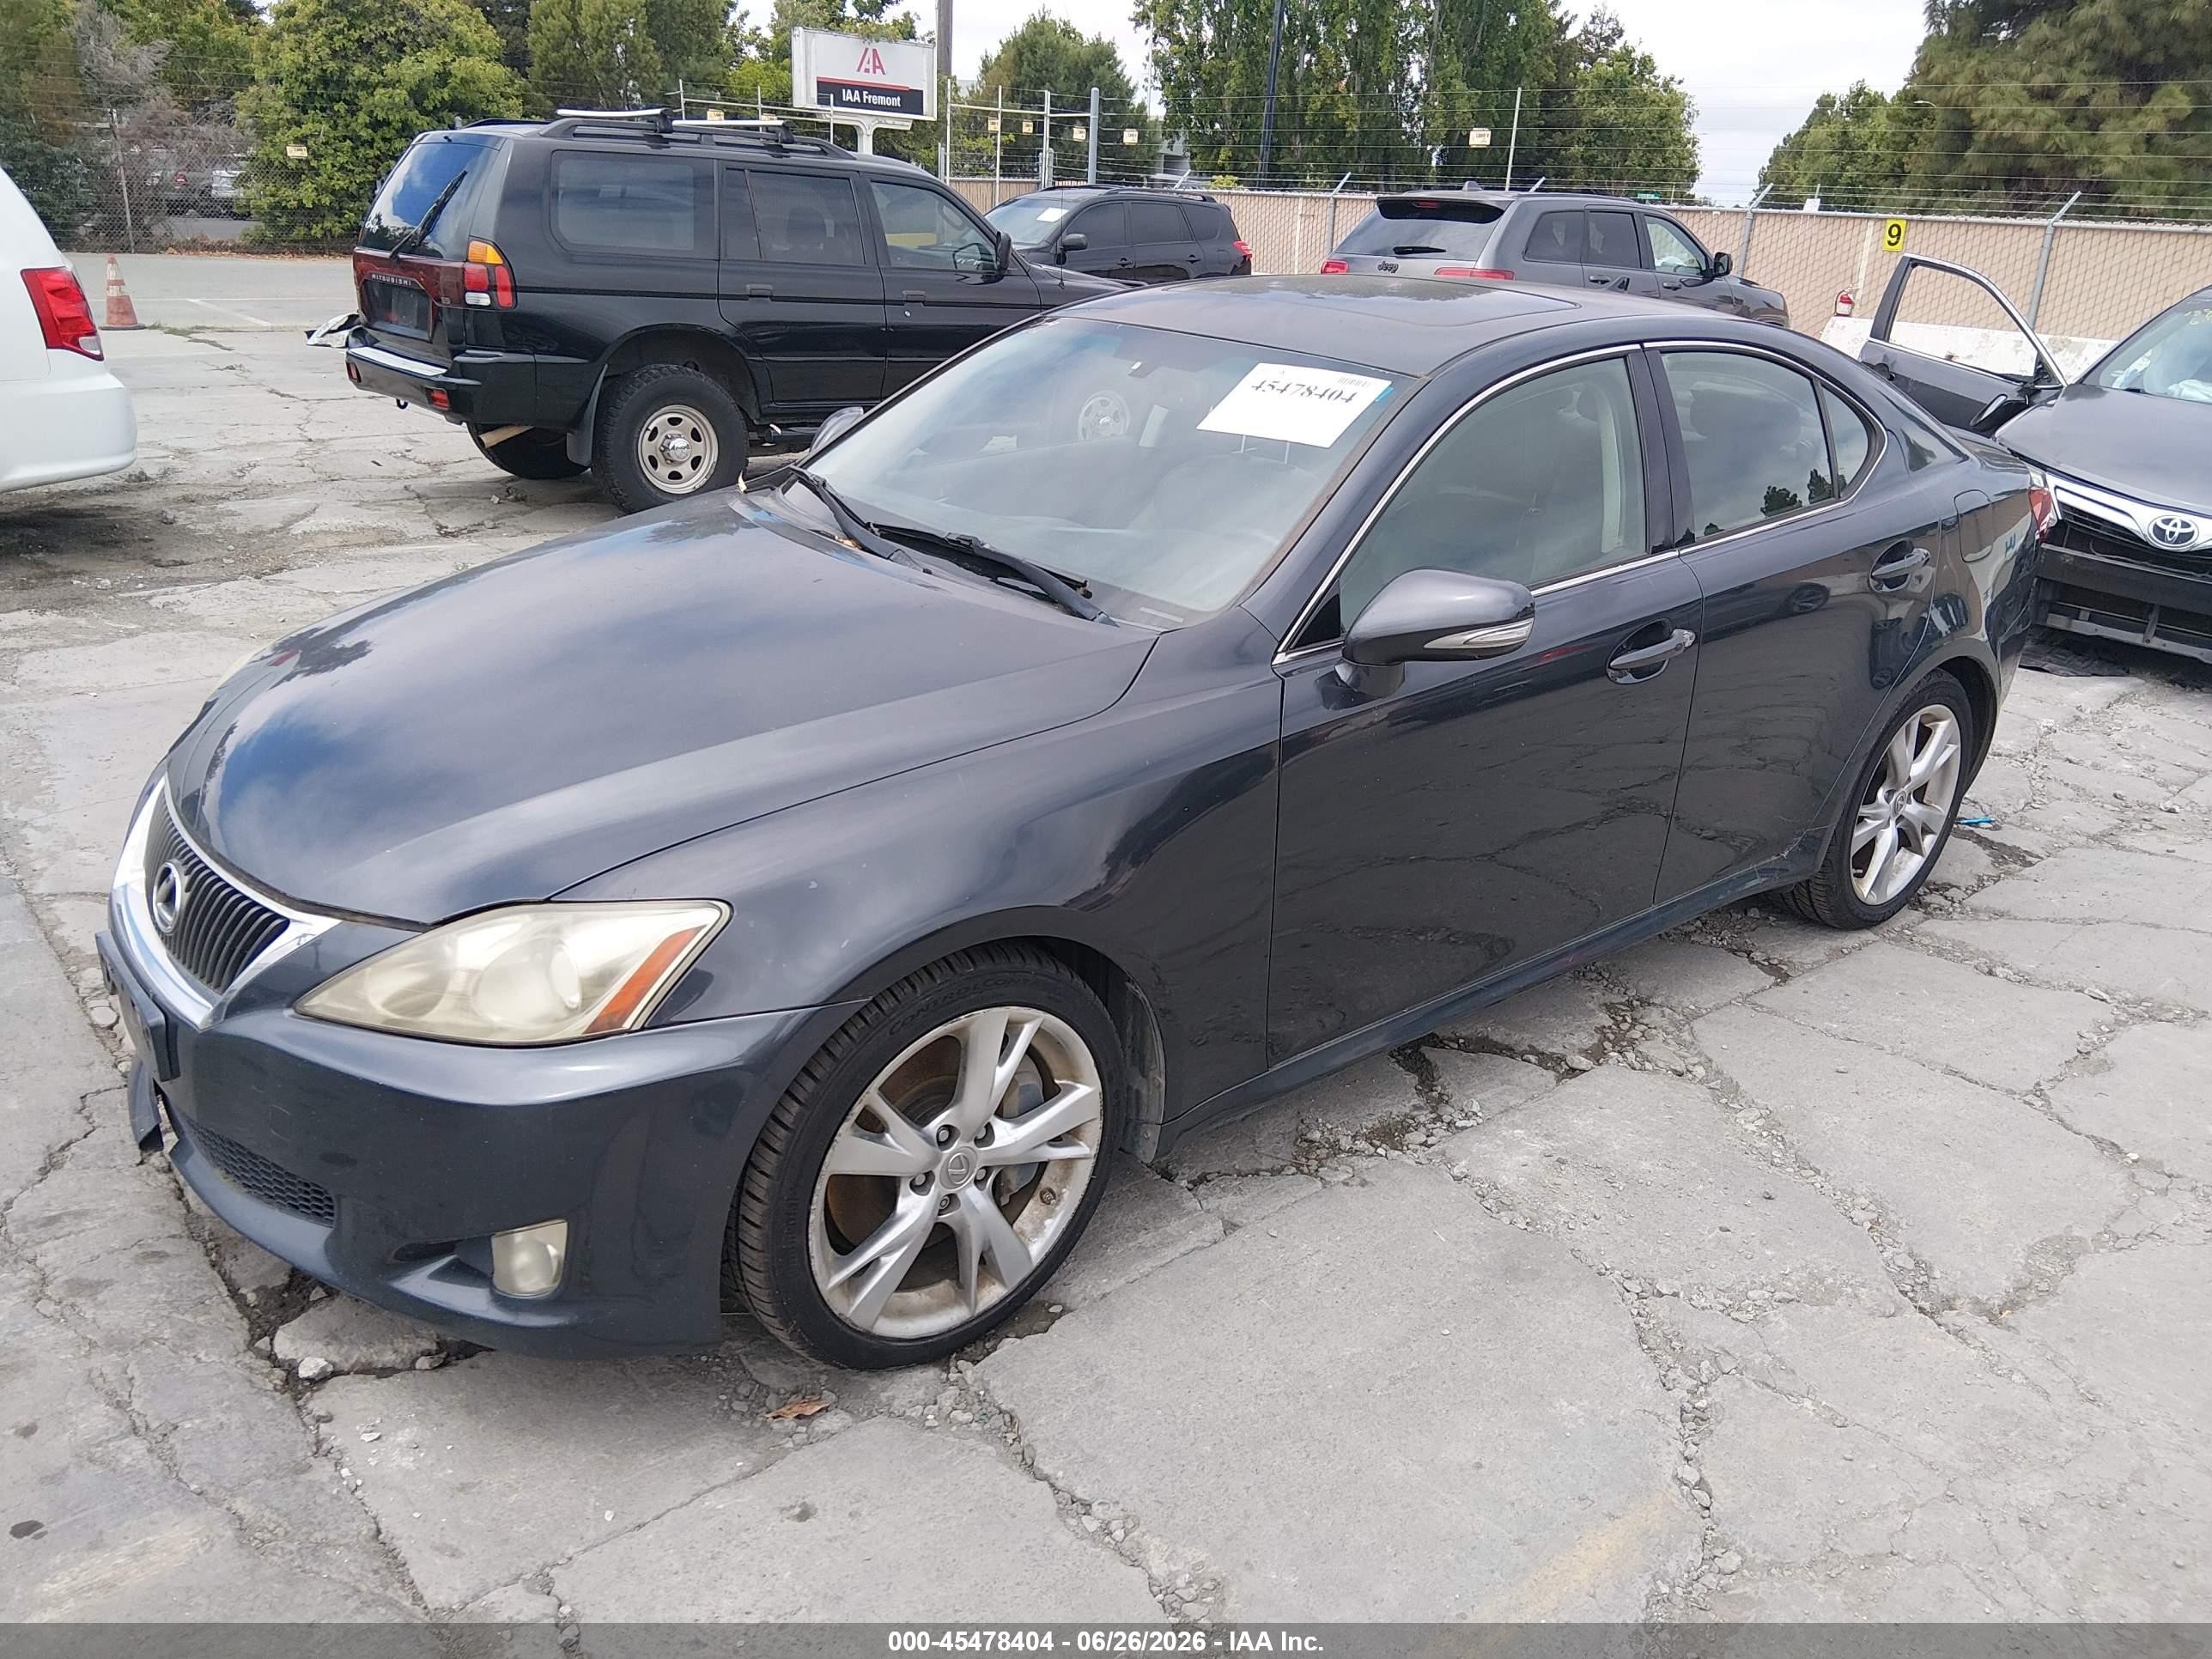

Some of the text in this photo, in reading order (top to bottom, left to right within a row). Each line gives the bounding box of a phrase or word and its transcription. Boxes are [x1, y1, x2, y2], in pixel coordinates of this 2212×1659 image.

[842, 88, 902, 107] IAA Fremont
[1887, 223, 1902, 246] 9
[1376, 260, 1399, 274] Jeep
[371, 273, 411, 286] MITSUBISHI
[1251, 379, 1358, 404] 45478404
